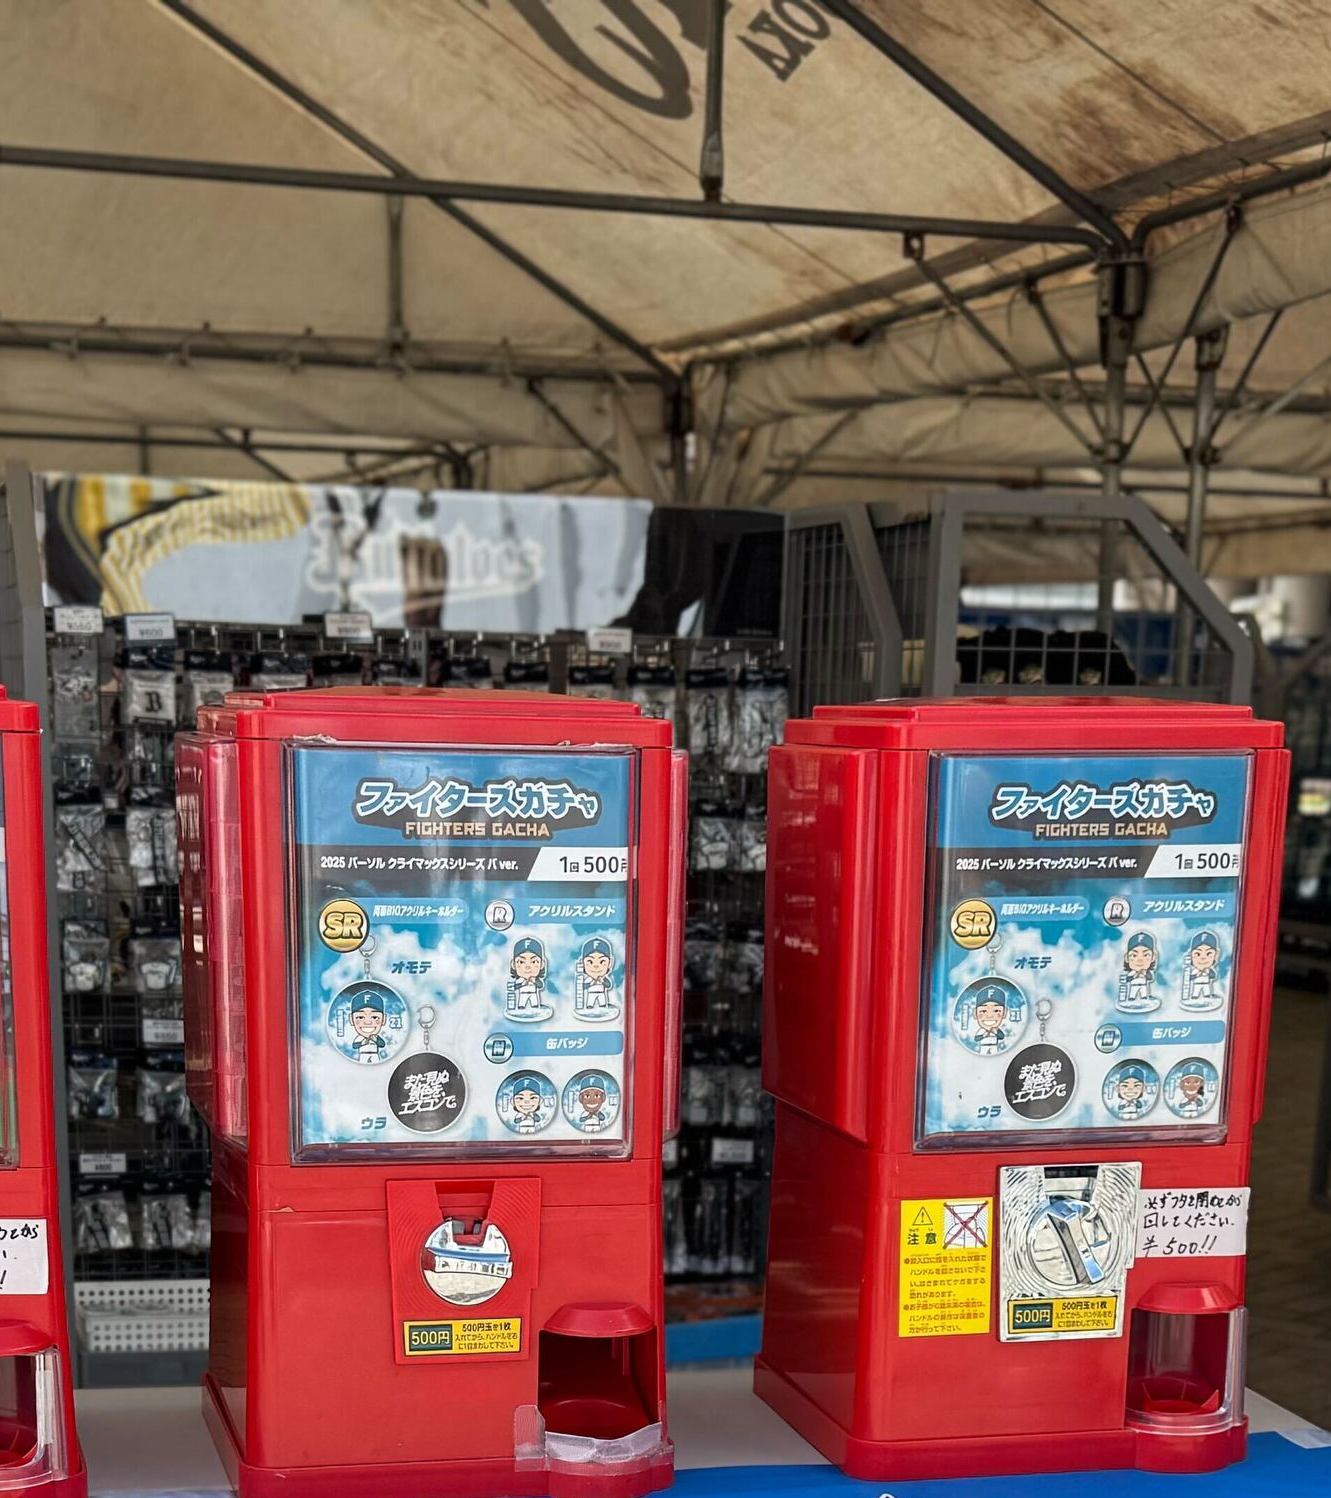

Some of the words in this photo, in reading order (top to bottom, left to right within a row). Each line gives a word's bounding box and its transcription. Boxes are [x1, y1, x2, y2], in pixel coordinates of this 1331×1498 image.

[355, 780, 599, 818] ファイターズガチャ
[991, 783, 1215, 821] ファイターズガチャ
[405, 821, 486, 836] FIGHTERS
[492, 822, 550, 837] GACHA
[1035, 823, 1109, 837] FIGHTERS
[1115, 822, 1168, 837] GACHA
[320, 857, 346, 869] 2025
[388, 857, 484, 870] クライマックスシリーズ
[499, 858, 518, 870] ver.
[956, 858, 979, 870] 2025
[1017, 857, 1107, 870] クライマックスシリーズ
[1119, 857, 1137, 869] ver.
[528, 904, 616, 917] アクリルスタンド
[1110, 904, 1124, 920] R
[1143, 900, 1225, 912] アクリルスタンド
[493, 907, 507, 923] R
[324, 912, 364, 939] SR
[954, 911, 992, 937] SR
[391, 961, 432, 974] オモテ
[1014, 956, 1052, 969] オモテ
[1152, 1026, 1191, 1039] 缶バッジ
[546, 1037, 588, 1050] 缶バッジ
[977, 1105, 1001, 1118] ウラ
[361, 1117, 386, 1130] ウラ
[908, 1232, 937, 1245] 注意
[1015, 1310, 1050, 1323] 500円
[411, 1331, 450, 1345] 500円
